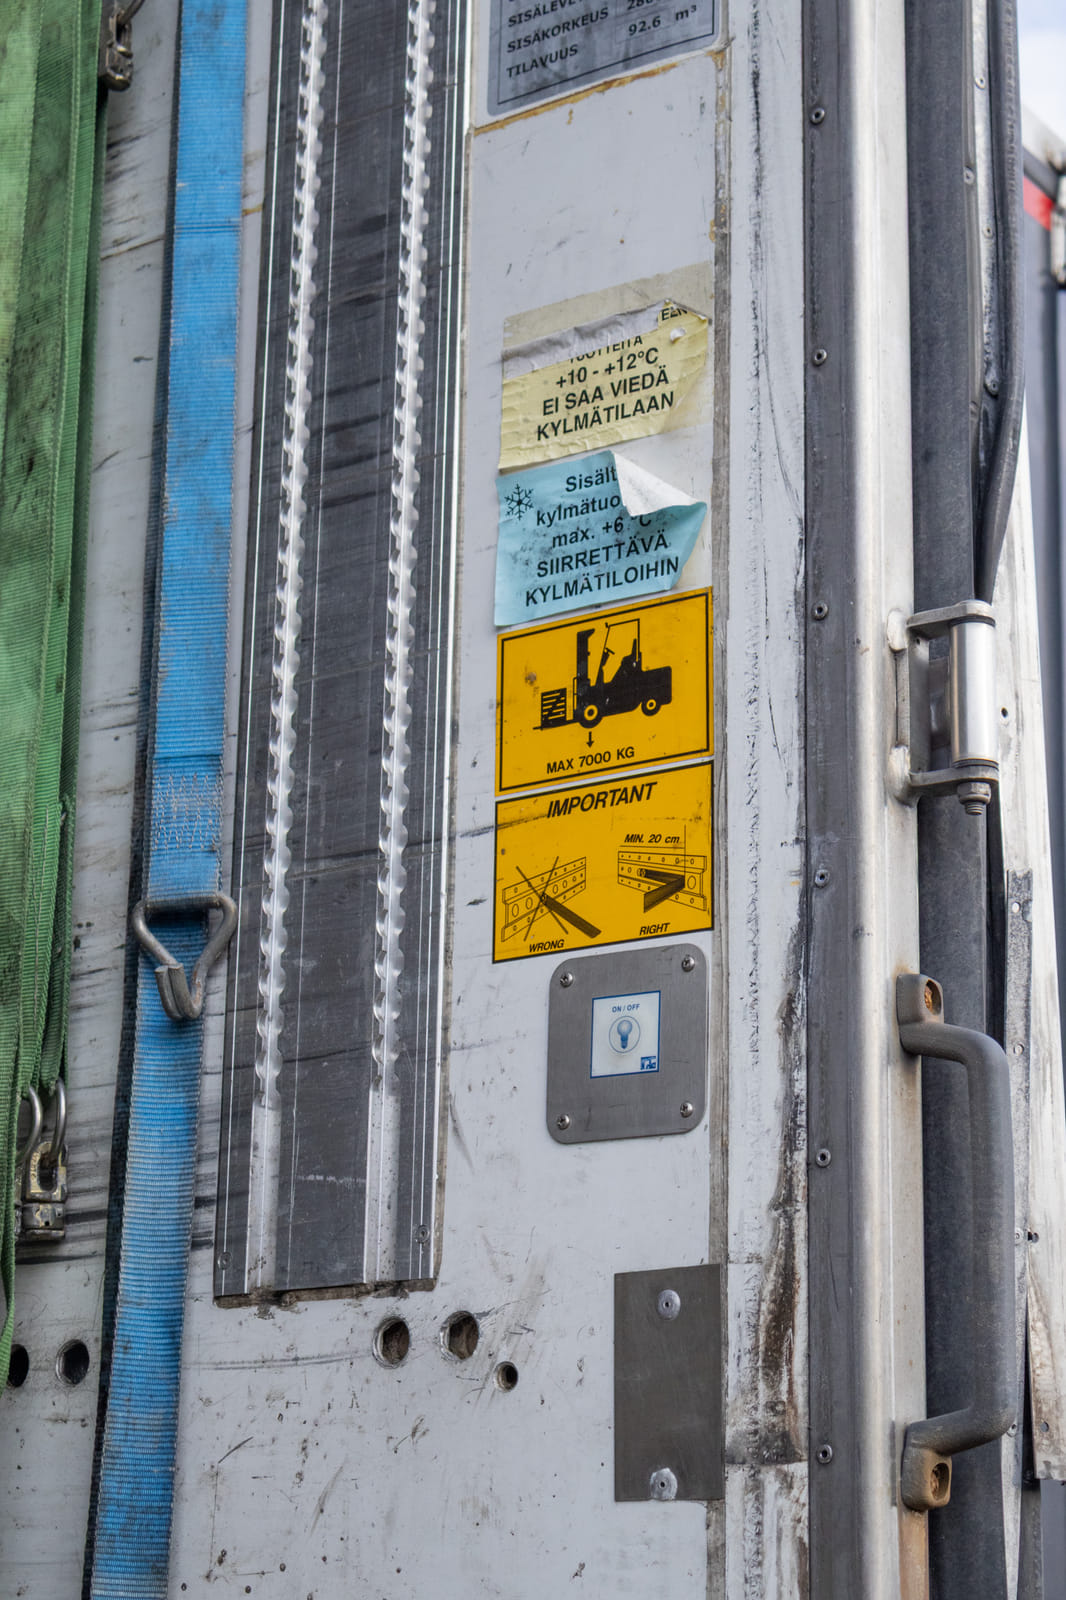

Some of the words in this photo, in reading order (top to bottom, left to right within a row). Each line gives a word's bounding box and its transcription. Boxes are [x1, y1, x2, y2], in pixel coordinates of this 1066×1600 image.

[506, 44, 578, 78] TILAVUUS
[628, 15, 661, 36] 92.6
[507, 7, 609, 53] SISÄKORKEUS
[543, 398, 559, 416] EI
[565, 386, 604, 410] SAA
[610, 365, 670, 397] VIEDÄ
[556, 366, 588, 389] +10
[537, 391, 675, 441] KYLMÄTILAAN
[536, 529, 669, 578] SIIRRETTÄVÄ
[551, 527, 595, 550] max.
[525, 557, 679, 607] KYLMÄTILOIHIN
[546, 758, 574, 774] MAX
[579, 751, 611, 768] 7000
[616, 747, 635, 761] KG
[546, 781, 658, 818] IMPORTANT
[624, 834, 645, 844] MIN.
[648, 834, 662, 844] 20
[664, 835, 680, 844] cm
[529, 938, 565, 953] WRONG
[639, 922, 670, 936] RIGHT
